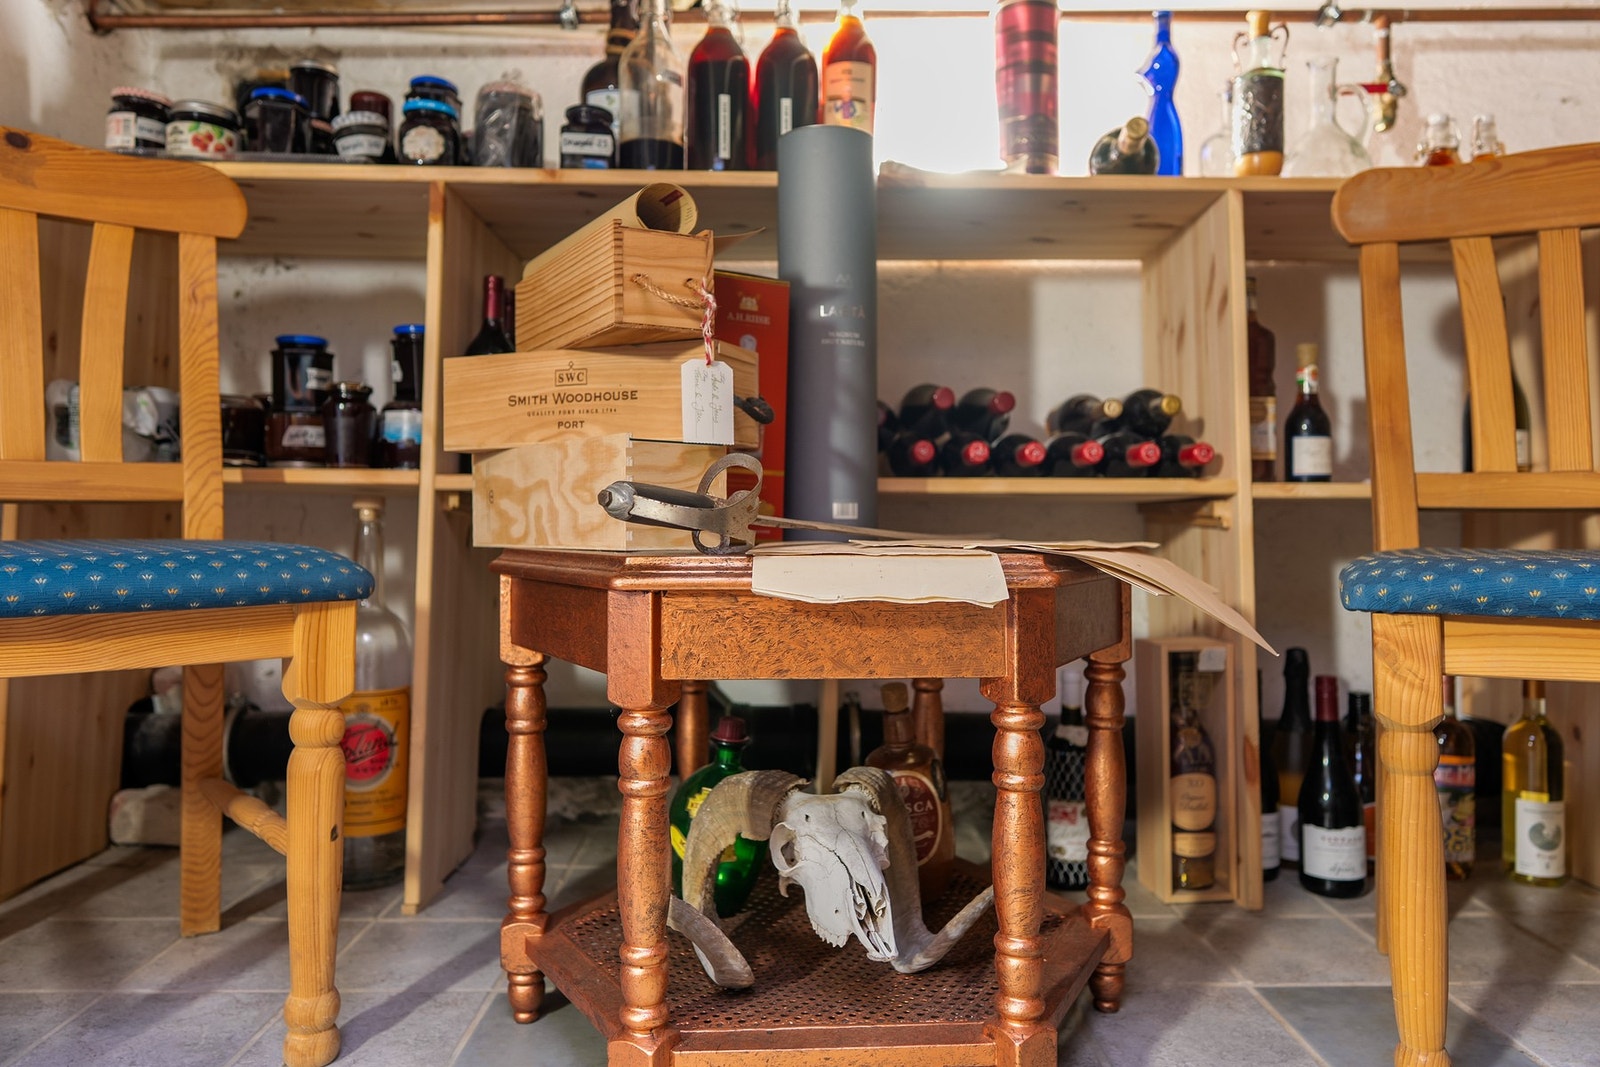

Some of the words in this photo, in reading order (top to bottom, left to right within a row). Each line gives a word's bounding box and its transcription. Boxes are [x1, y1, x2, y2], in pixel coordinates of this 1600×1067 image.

[558, 372, 585, 383] SWC
[508, 395, 548, 407] SMITH
[552, 390, 638, 405] WOODHOUSE
[557, 420, 585, 429] PORT
[904, 799, 934, 814] SCA
